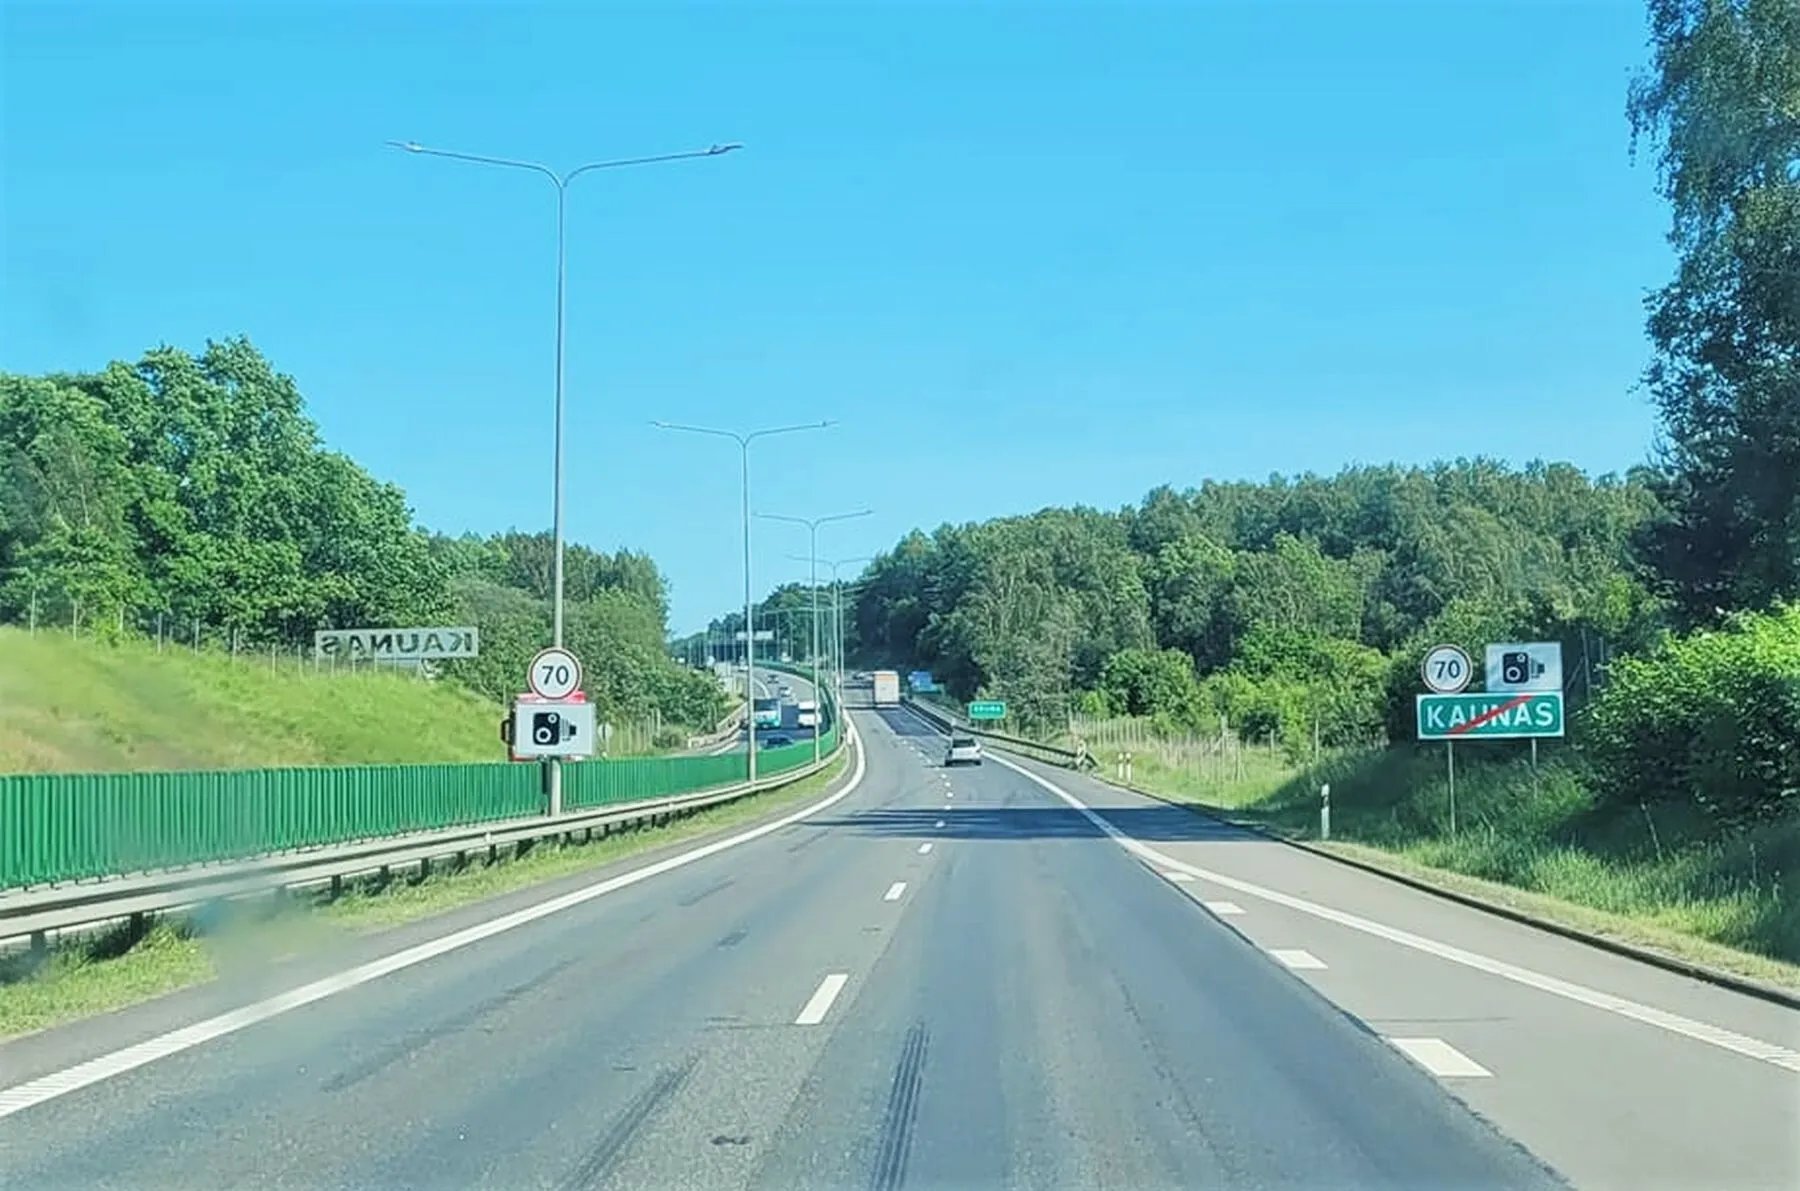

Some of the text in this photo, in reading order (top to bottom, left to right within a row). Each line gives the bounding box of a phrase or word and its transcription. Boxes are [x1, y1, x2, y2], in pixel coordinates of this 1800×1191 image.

[542, 665, 569, 686] 70
[1434, 659, 1461, 679] 70
[1426, 702, 1554, 729] KAUNAS
